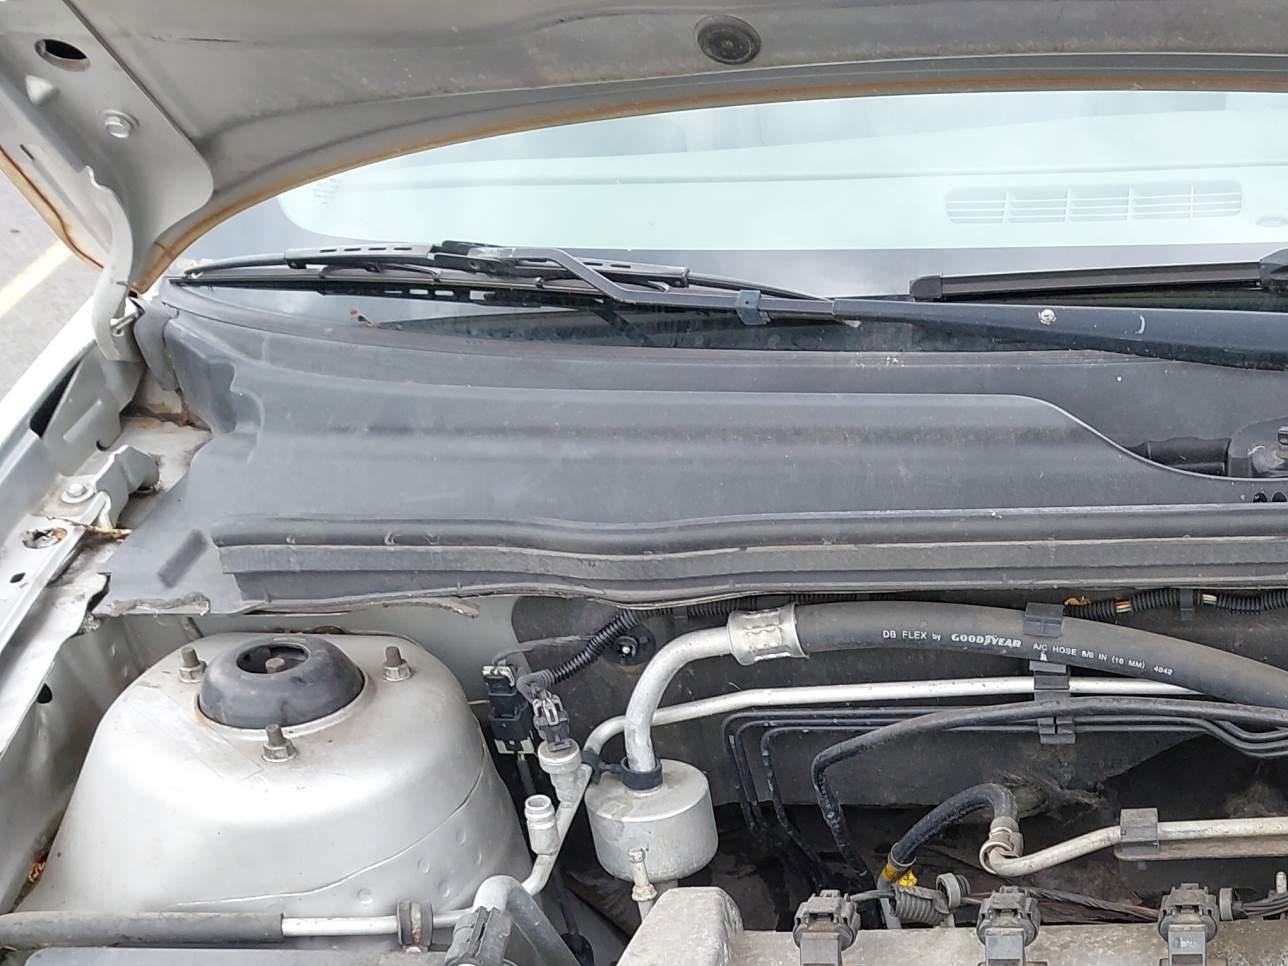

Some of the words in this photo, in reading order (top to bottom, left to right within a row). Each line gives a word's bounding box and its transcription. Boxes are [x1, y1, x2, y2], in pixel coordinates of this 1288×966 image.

[882, 630, 897, 639] DB
[902, 631, 927, 640] FLEX
[931, 632, 942, 641] by
[951, 633, 1022, 648] GOODYEAR
[1033, 643, 1048, 652] A/C
[1052, 646, 1077, 656] HOSE
[1098, 653, 1107, 661] IN
